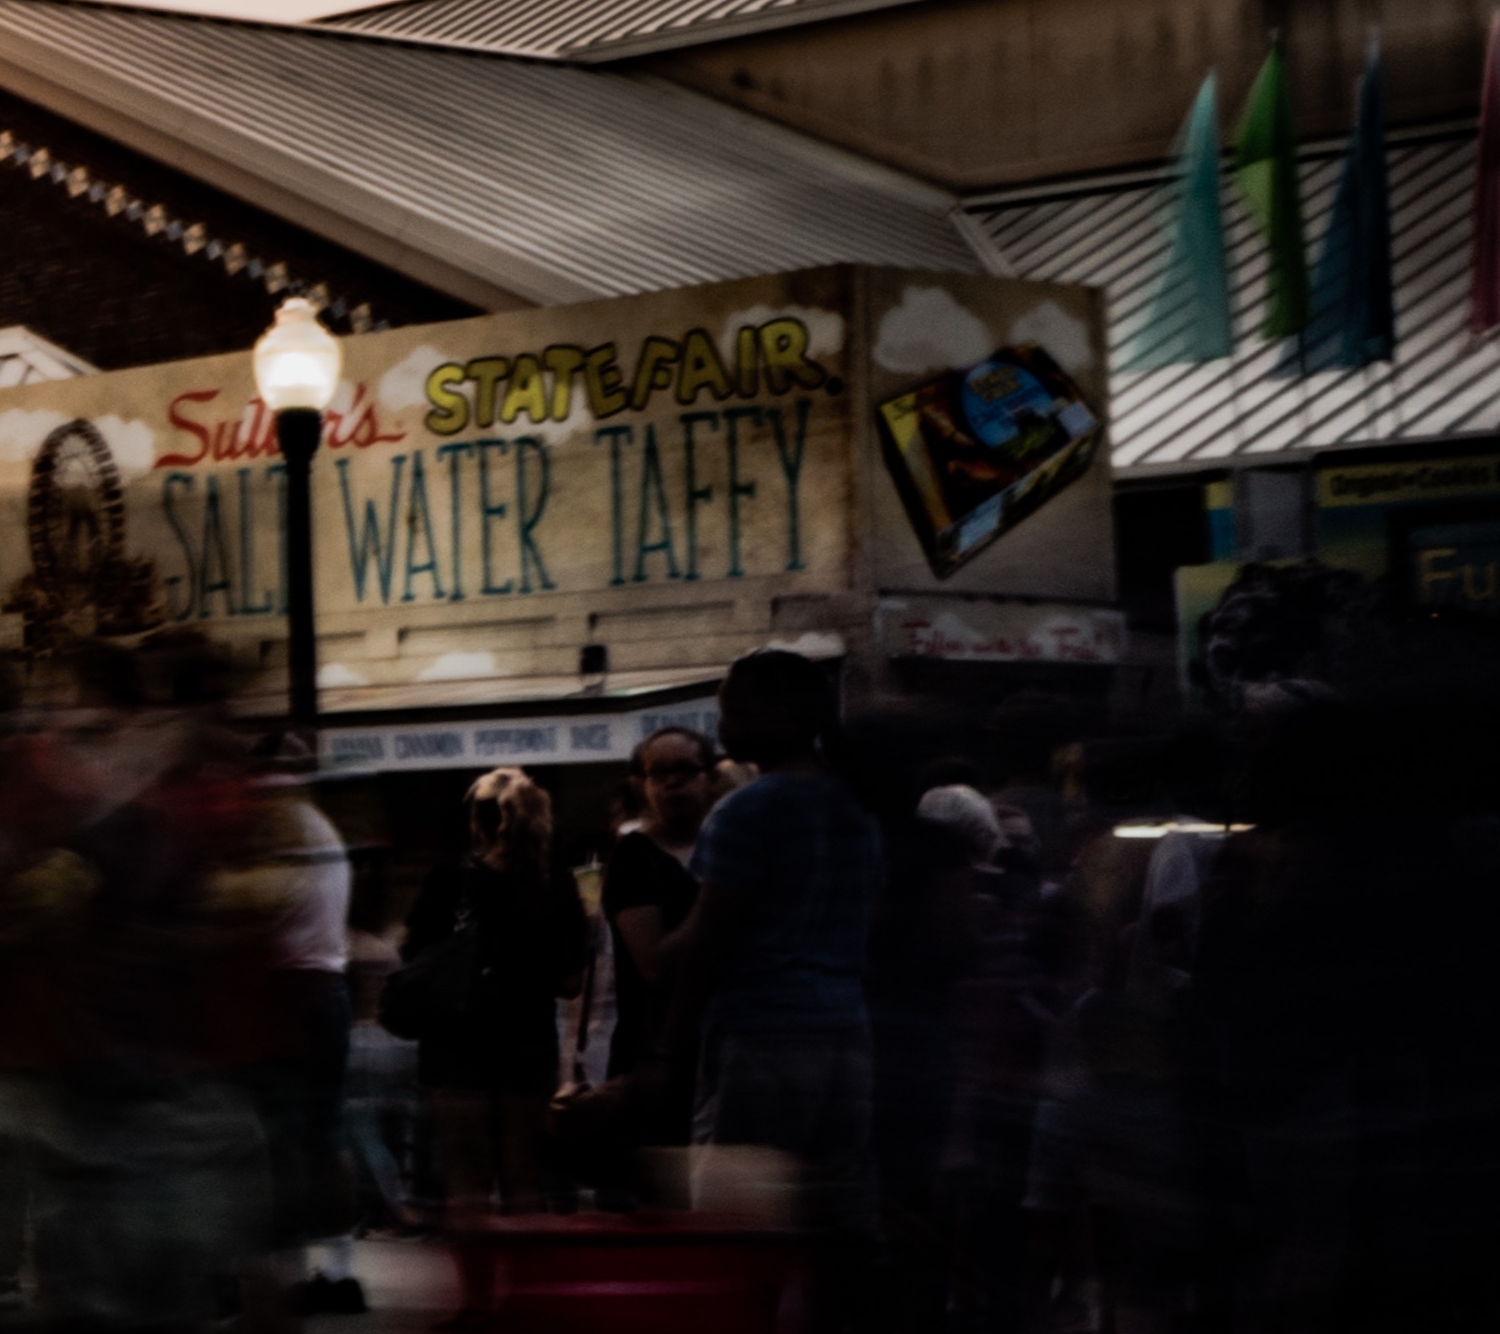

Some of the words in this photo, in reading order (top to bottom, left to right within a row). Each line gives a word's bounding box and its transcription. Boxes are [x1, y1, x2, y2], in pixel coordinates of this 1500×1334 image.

[154, 381, 406, 467] Sutr's
[423, 342, 629, 436] STATE
[334, 436, 556, 605] WATER
[594, 398, 813, 587] TAFFY
